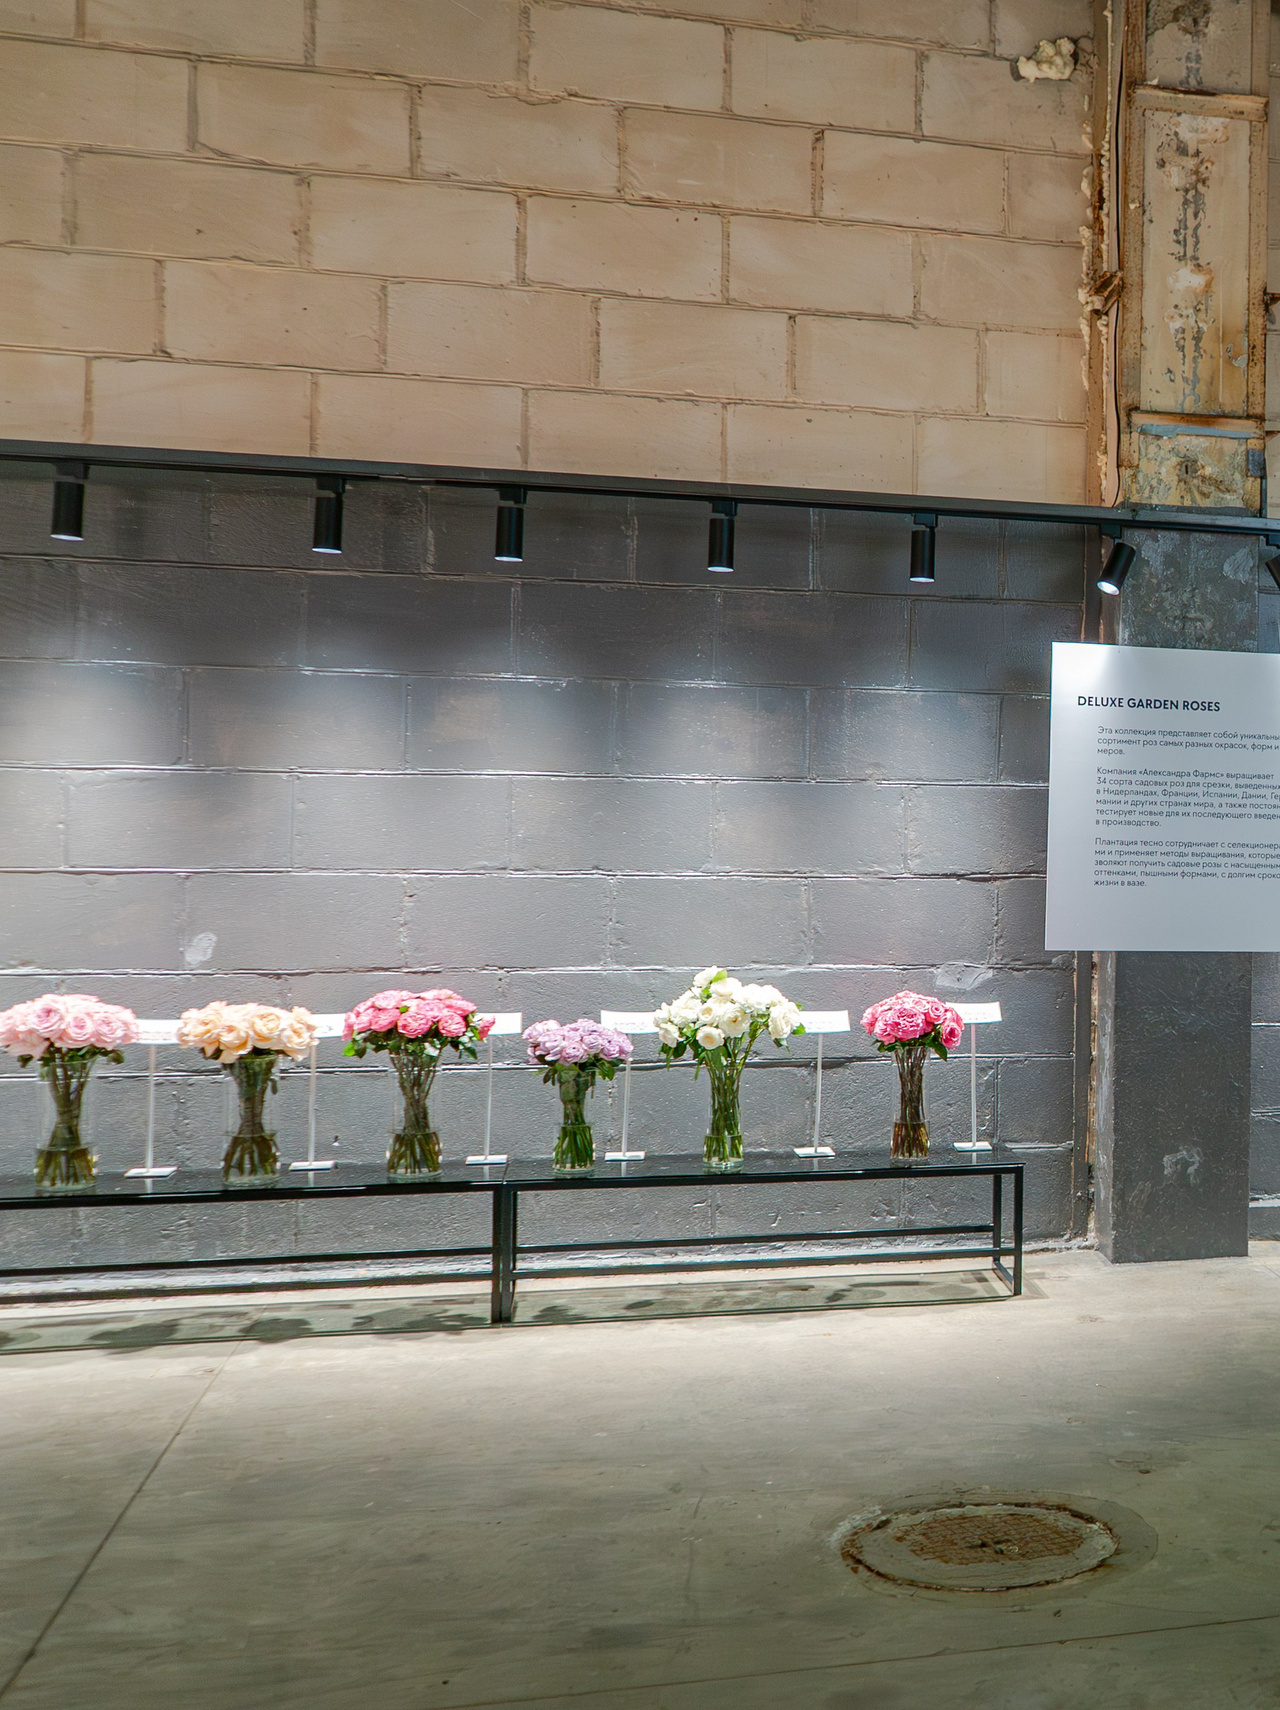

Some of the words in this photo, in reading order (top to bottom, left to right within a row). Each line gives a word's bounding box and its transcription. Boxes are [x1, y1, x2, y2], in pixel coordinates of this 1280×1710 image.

[1078, 696, 1124, 708] DELUXE
[1127, 698, 1179, 710] GARDEN
[1182, 701, 1220, 712] ROSES
[1097, 726, 1113, 734] Эта
[1114, 729, 1157, 737] коллекция
[1158, 730, 1212, 739] представляет
[1213, 730, 1238, 739] собой
[1097, 738, 1141, 746] сортимент
[1185, 741, 1213, 749] разных
[1214, 742, 1249, 751] окрасок,
[1250, 742, 1273, 751] форм
[1096, 767, 1137, 775] Компания
[1138, 769, 1191, 777] «Александра
[1192, 770, 1224, 779] Фармс»
[1226, 773, 1274, 781] выращивает
[1096, 776, 1107, 785] 34
[1108, 779, 1133, 787] сорта
[1134, 780, 1169, 788] садовых
[1185, 781, 1201, 789] для
[1202, 782, 1233, 790] срезки,
[1103, 787, 1160, 797] Нидерландах,
[1161, 789, 1200, 799] Франции,
[1202, 790, 1240, 800] Испании,
[1241, 791, 1269, 800] Дании,
[1159, 800, 1192, 808] странах
[1193, 801, 1216, 809] мира,
[1096, 809, 1137, 817] тестирует
[1192, 811, 1253, 819] последующего
[1102, 819, 1161, 827] производство.
[1095, 837, 1138, 847] Плантация
[1165, 840, 1219, 848] сотрудничает
[1114, 850, 1159, 858] применяет
[1159, 851, 1190, 859] методы
[1191, 852, 1246, 860] выращивания,
[1129, 860, 1166, 868] получить
[1166, 861, 1201, 869] садовые
[1202, 862, 1222, 870] розы
[1094, 870, 1138, 878] оттенками,
[1179, 869, 1219, 879] формами,
